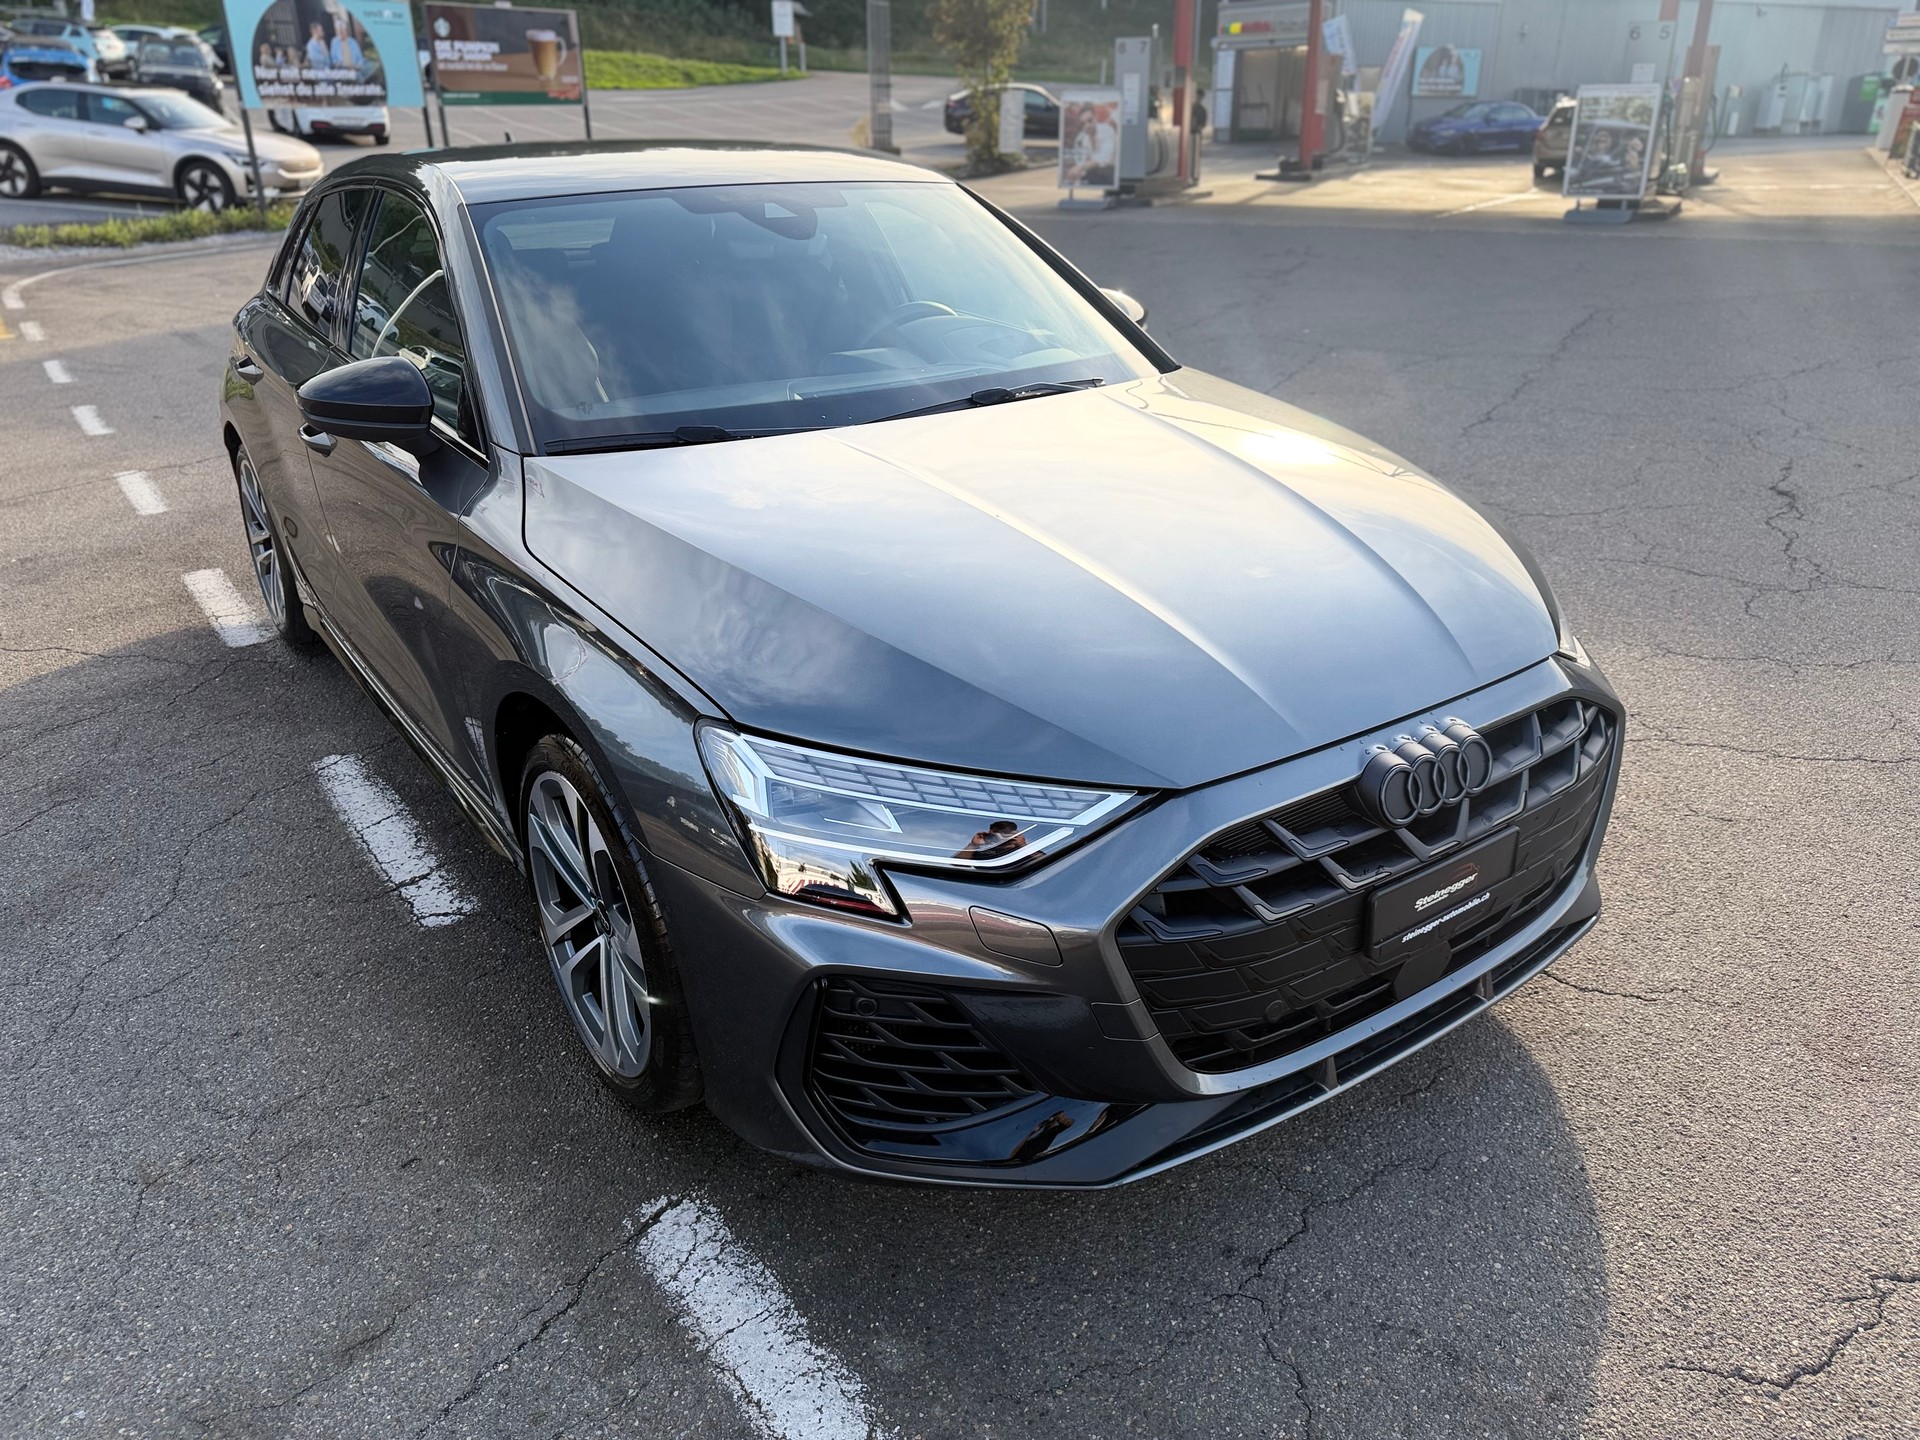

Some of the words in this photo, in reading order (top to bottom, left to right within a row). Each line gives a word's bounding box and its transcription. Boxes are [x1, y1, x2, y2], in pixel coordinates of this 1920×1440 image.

[1629, 26, 1641, 41] 6
[1659, 26, 1671, 41] 5
[254, 65, 278, 81] Nur
[279, 66, 300, 81] mit
[301, 66, 357, 81] newhome
[257, 81, 295, 97] siehst
[295, 81, 313, 97] du
[313, 81, 336, 97] alle
[1414, 872, 1478, 909] Steinegger
[1401, 891, 1491, 943] steinegger-automobile.ch
